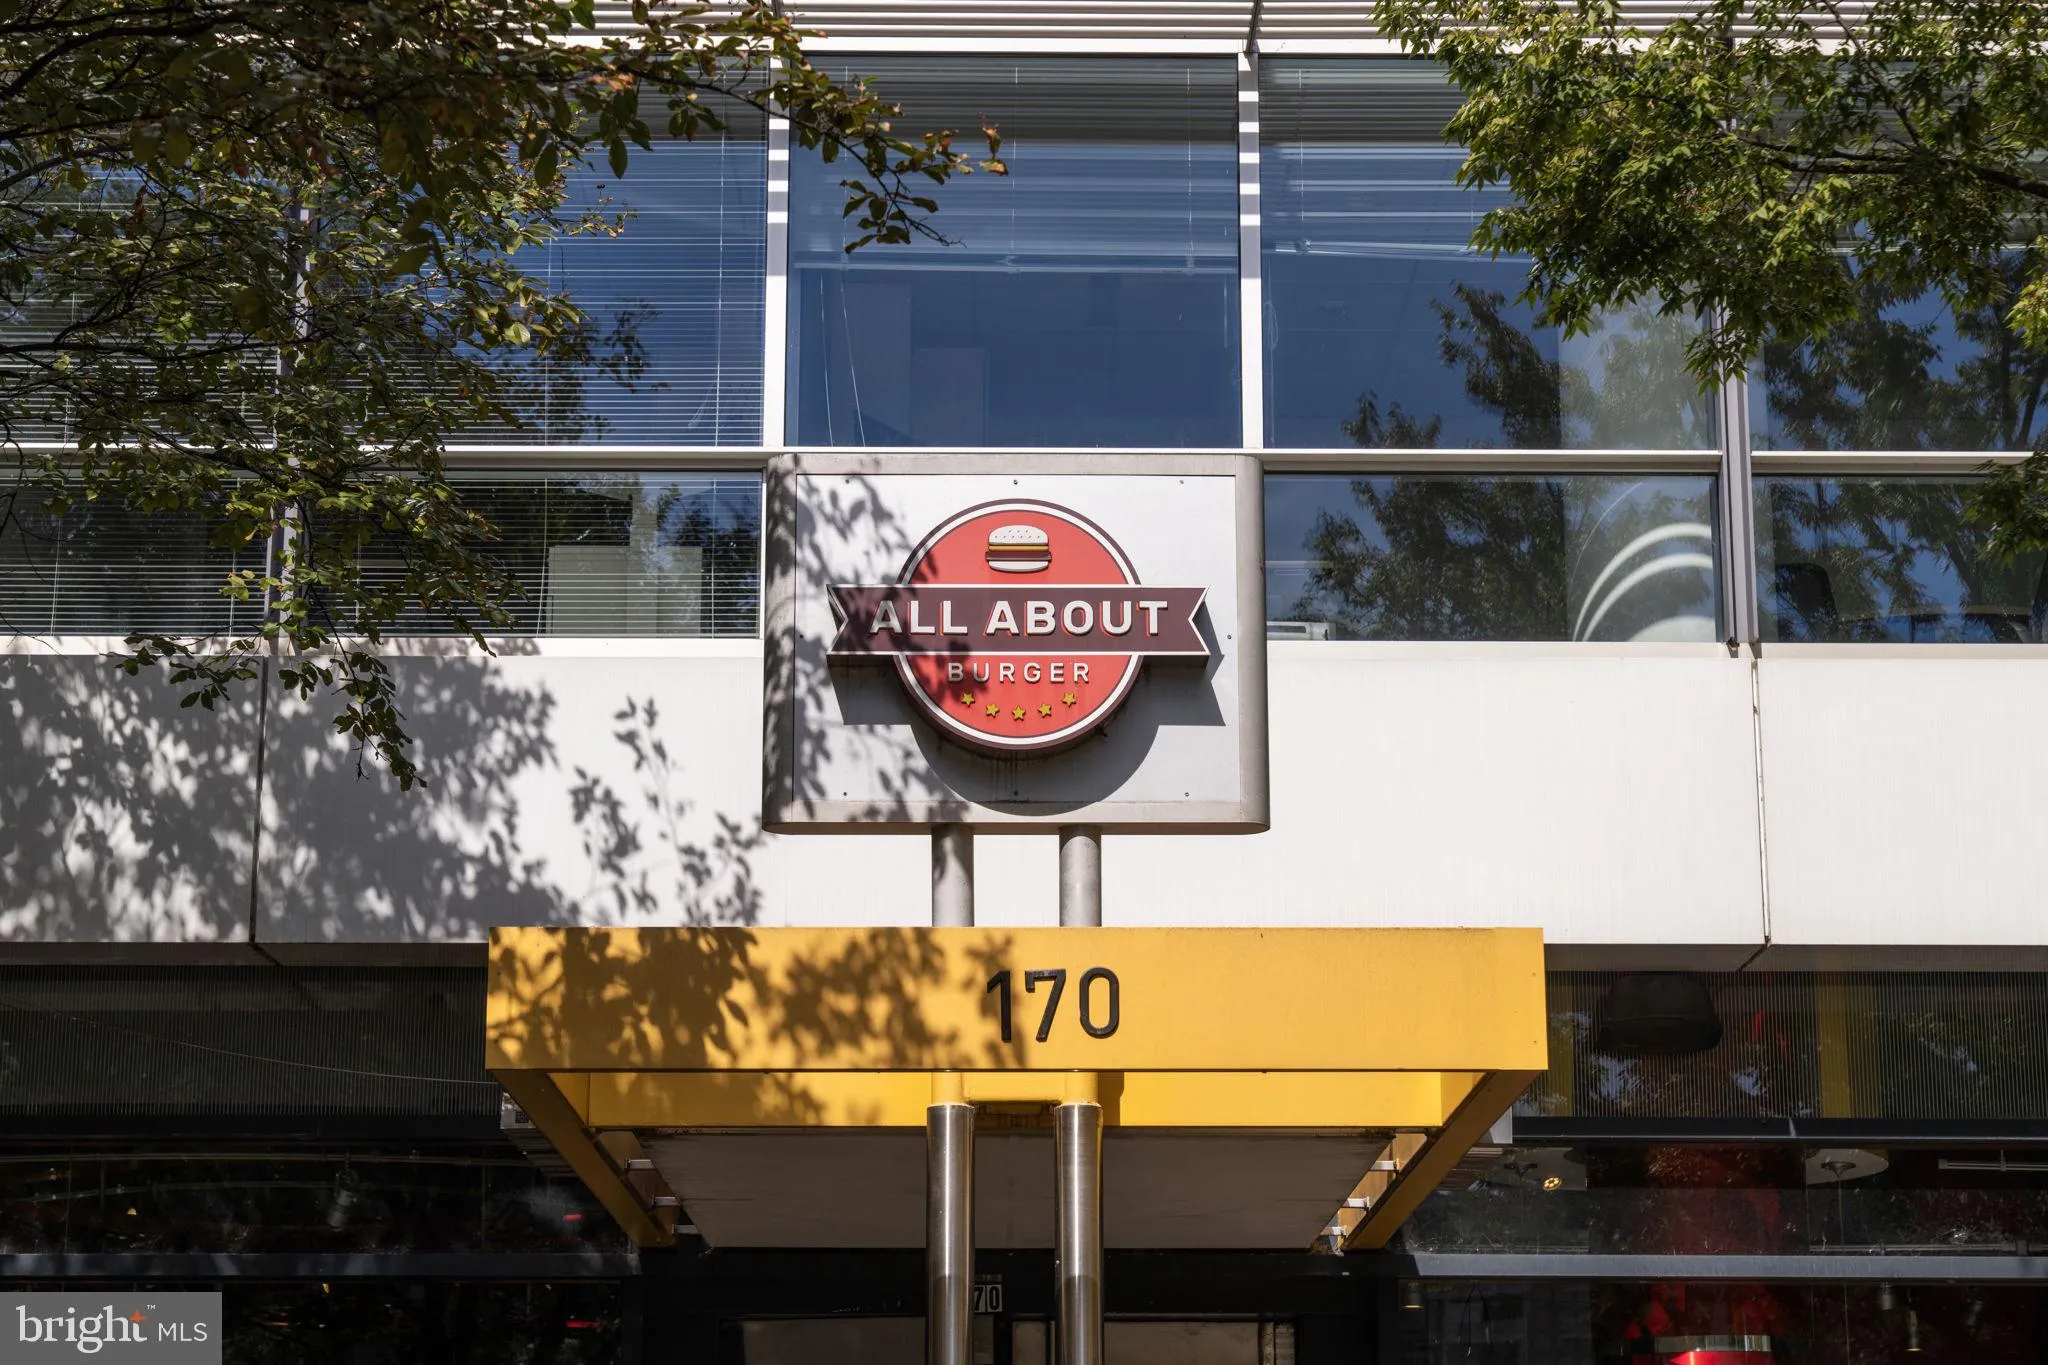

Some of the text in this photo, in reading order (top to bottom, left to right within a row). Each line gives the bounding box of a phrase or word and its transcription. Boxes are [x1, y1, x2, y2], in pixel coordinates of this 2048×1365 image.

[869, 600, 1168, 636] ALL ABOUT
[947, 662, 1090, 683] BURGER
[986, 967, 1120, 1043] 170
